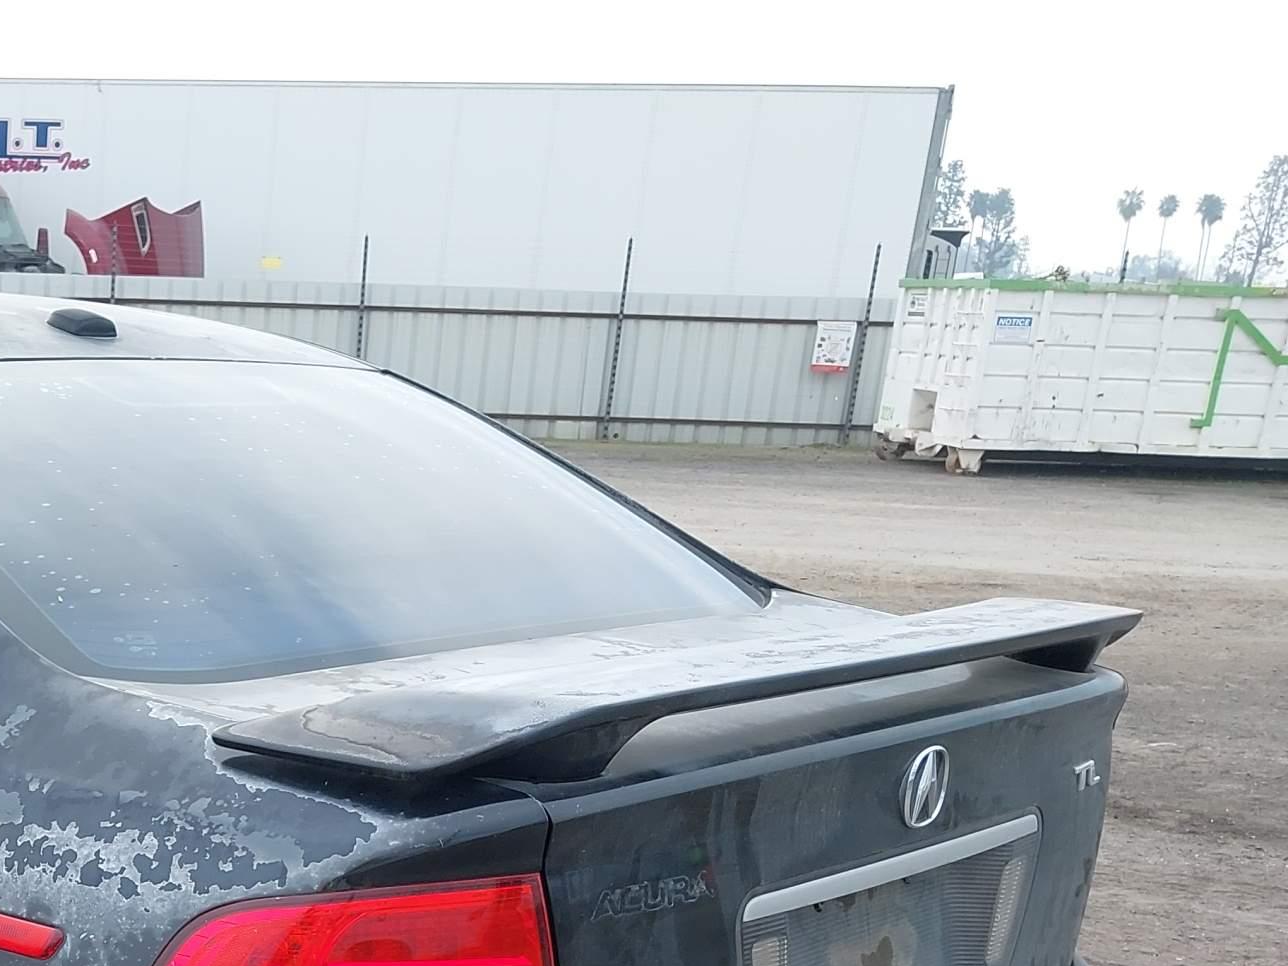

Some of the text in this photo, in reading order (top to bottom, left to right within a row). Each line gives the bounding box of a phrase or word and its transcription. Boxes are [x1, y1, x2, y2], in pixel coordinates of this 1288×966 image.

[998, 318, 1031, 326] NOTICE
[1073, 759, 1101, 791] TL
[590, 870, 715, 921] ACURA
